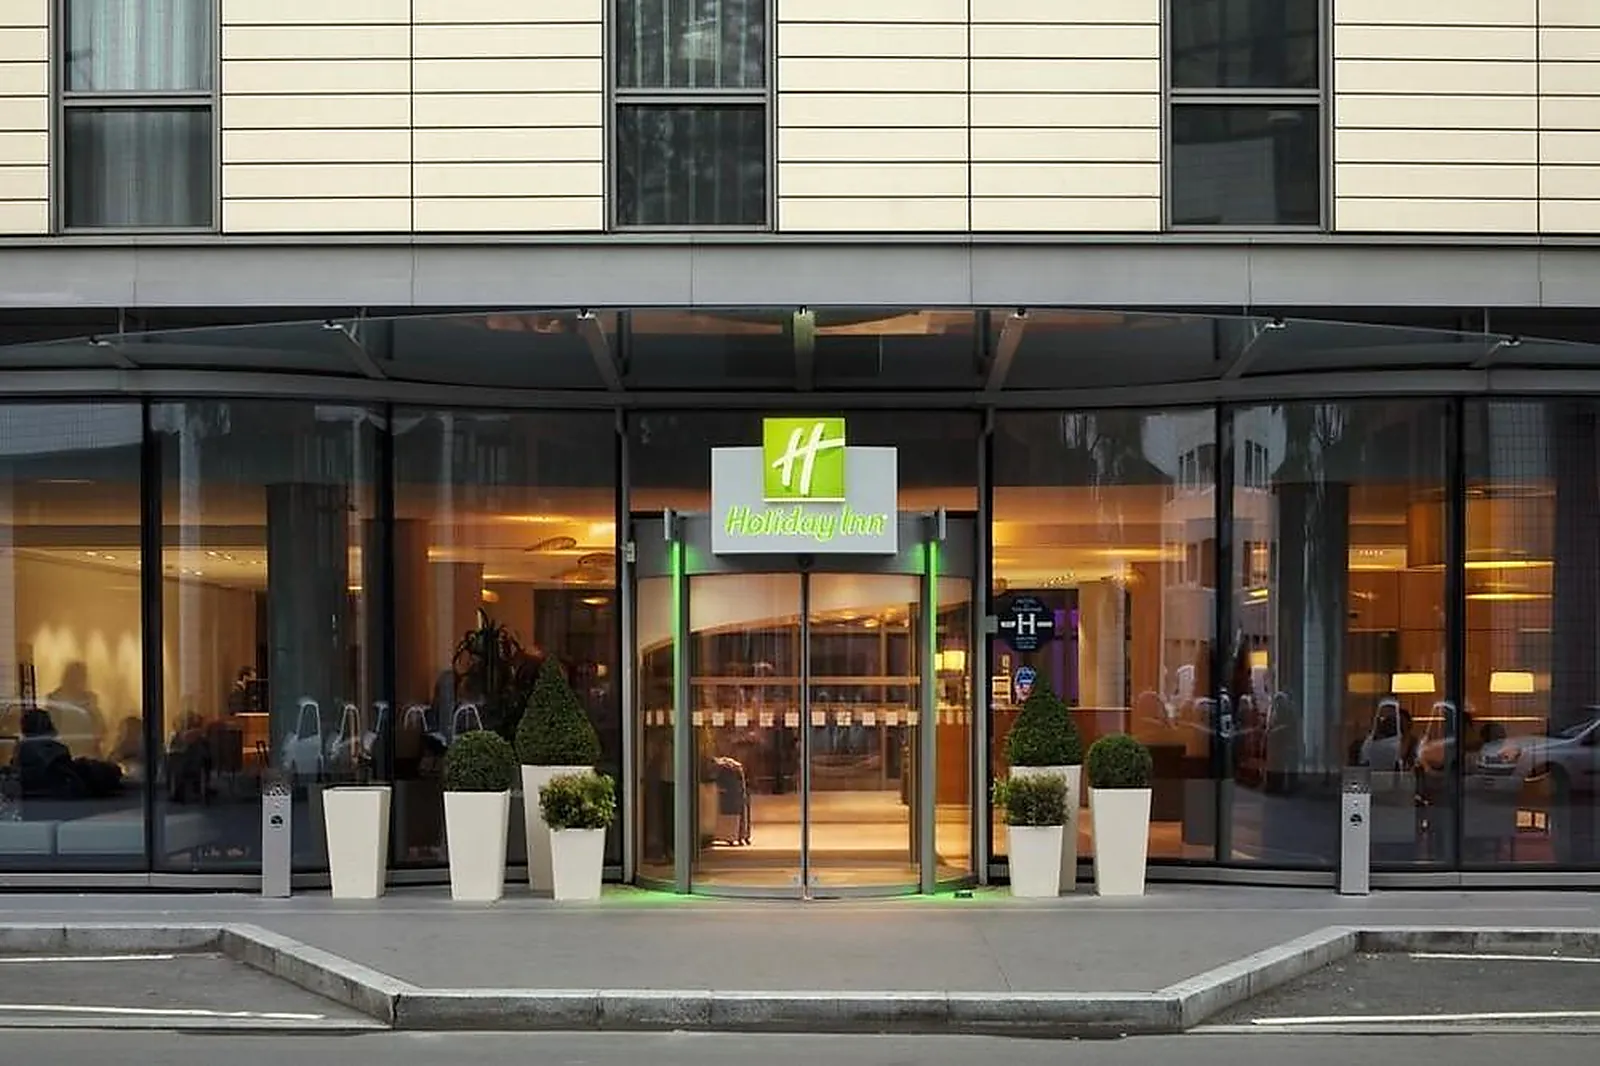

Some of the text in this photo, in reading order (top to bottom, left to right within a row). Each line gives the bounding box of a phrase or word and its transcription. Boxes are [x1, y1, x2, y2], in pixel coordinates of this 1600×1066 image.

[772, 422, 845, 496] H
[725, 505, 885, 542] Holiday Inn
[1017, 613, 1036, 635] H
